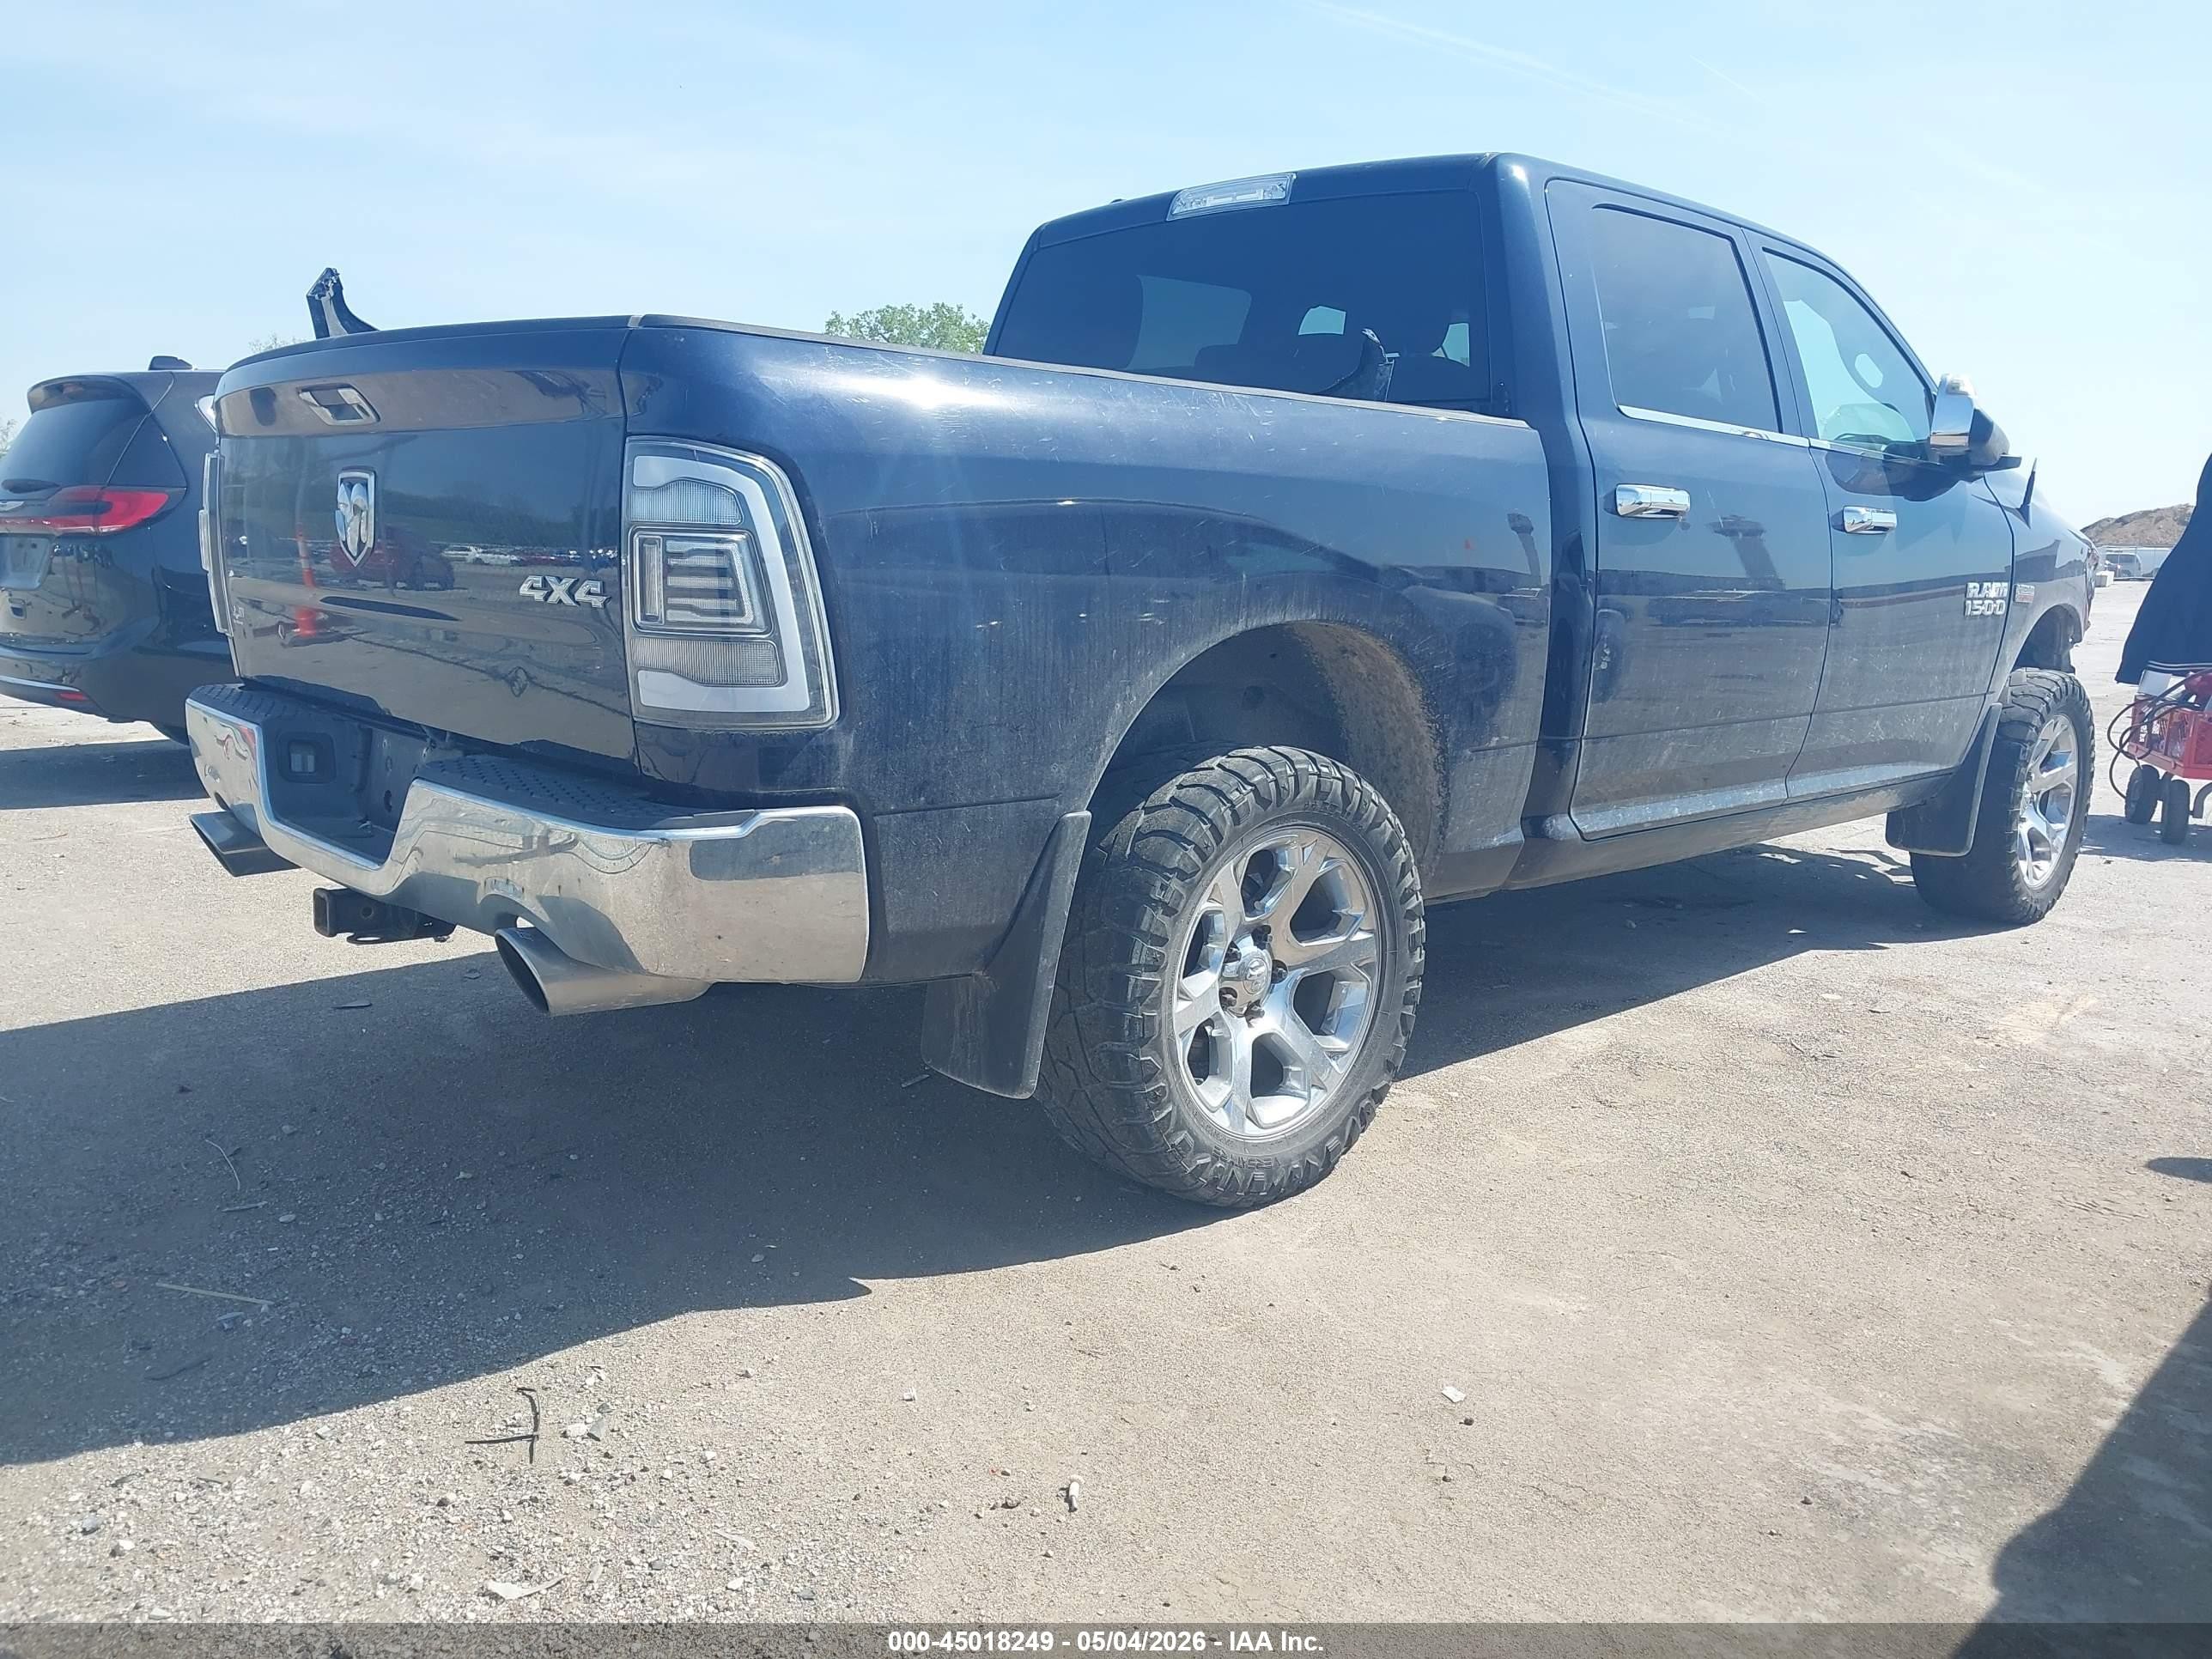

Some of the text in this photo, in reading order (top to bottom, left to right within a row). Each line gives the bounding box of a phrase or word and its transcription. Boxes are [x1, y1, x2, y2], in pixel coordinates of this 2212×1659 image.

[520, 575, 611, 608] 4X4
[1966, 582, 2008, 599] RAM
[1965, 599, 2006, 616] 1500
